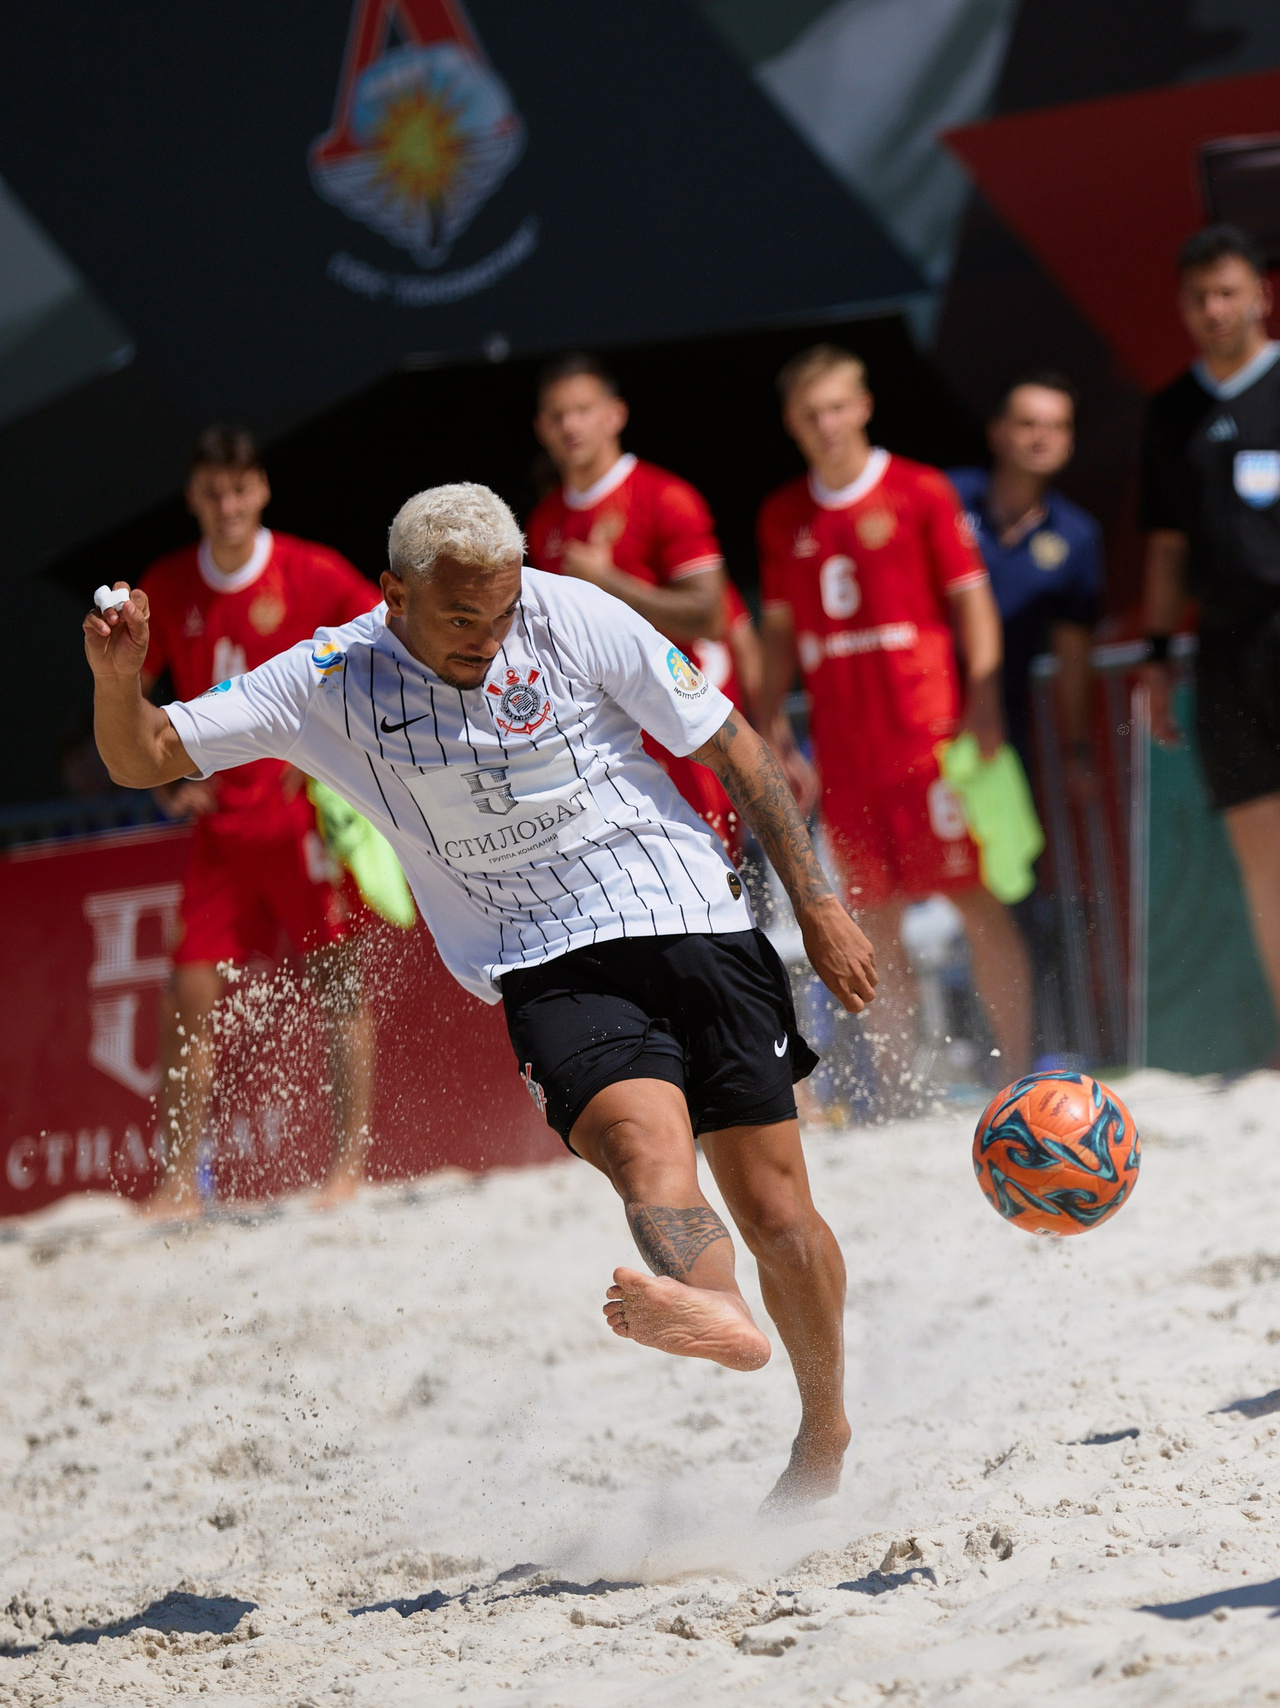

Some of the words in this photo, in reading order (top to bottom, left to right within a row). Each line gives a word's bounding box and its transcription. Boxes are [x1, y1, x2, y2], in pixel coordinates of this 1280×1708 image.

[820, 553, 861, 620] 6
[673, 686, 701, 700] INSTITUTO
[444, 791, 587, 859] СТИЛОБАТ
[488, 852, 517, 864] ГРУППА
[517, 833, 559, 856] КОМПАНИЙ
